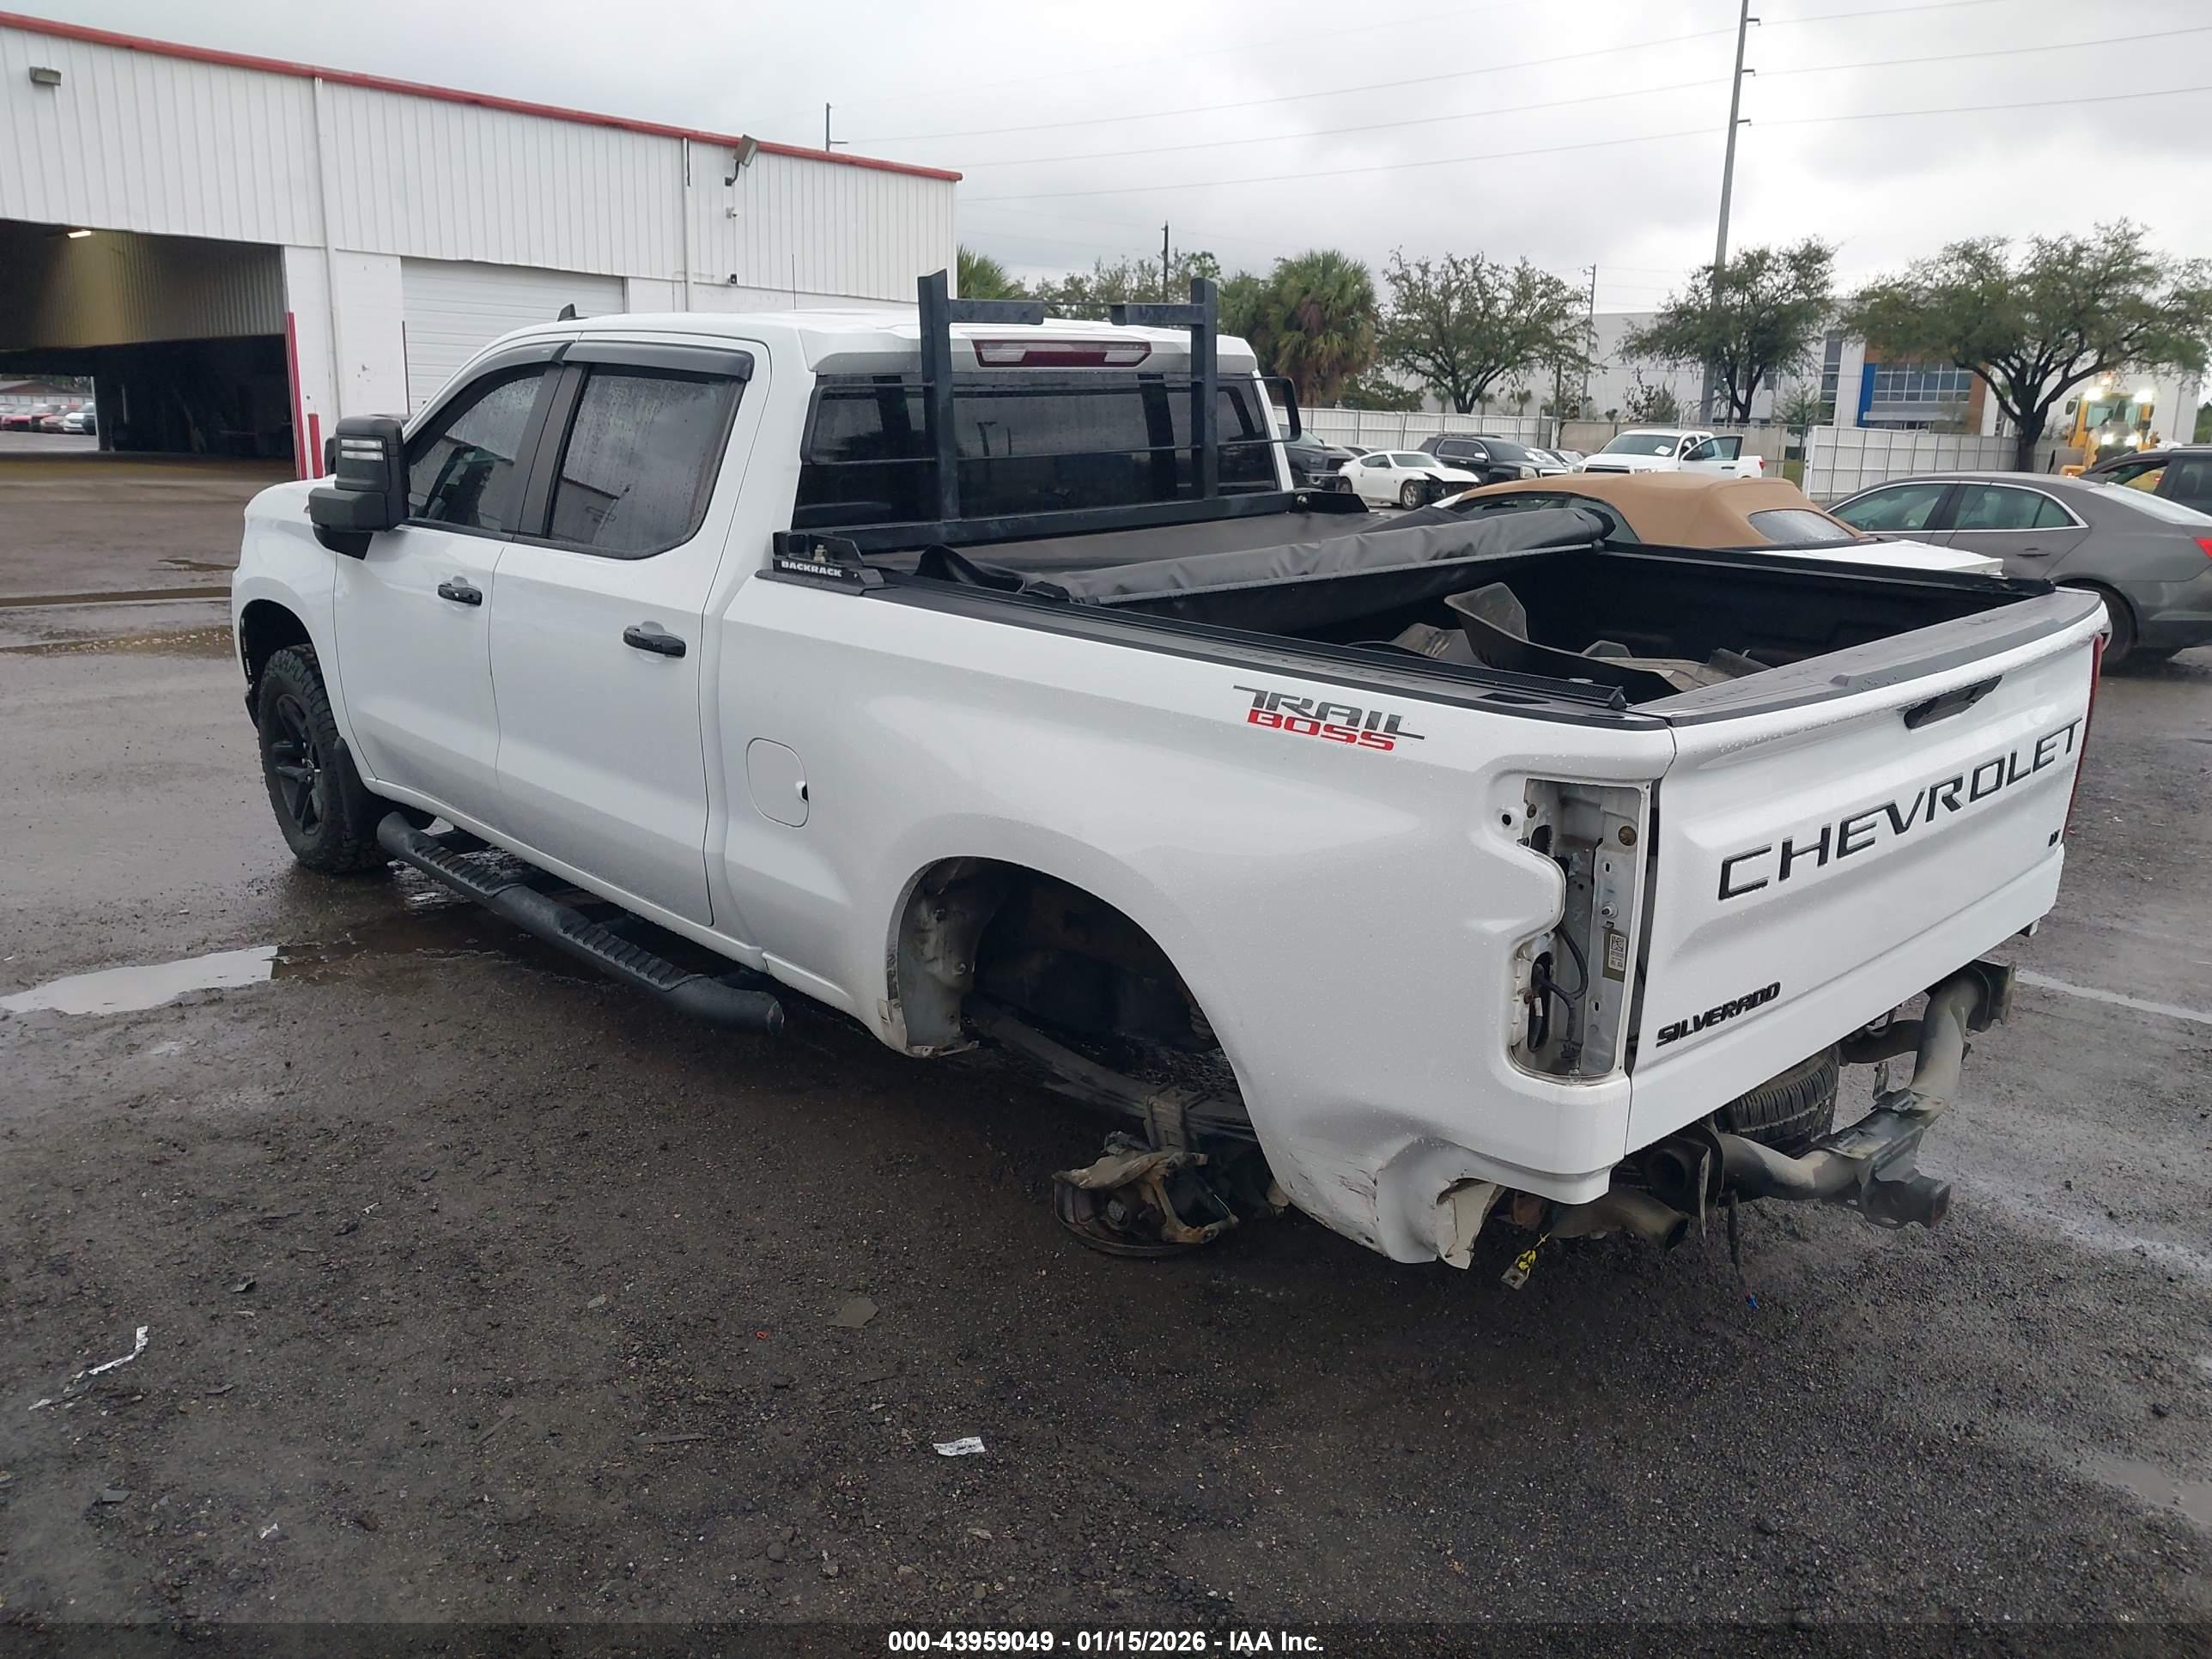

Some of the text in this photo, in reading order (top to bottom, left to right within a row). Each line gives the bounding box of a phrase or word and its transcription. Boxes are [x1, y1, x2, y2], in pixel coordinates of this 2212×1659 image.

[781, 560, 842, 577] BACKRACK
[1233, 684, 1425, 740] TRAIL
[1247, 708, 1396, 751] BOSS
[1717, 717, 2082, 901] CHEVROLET
[1656, 981, 1781, 1048] SILVERADO
